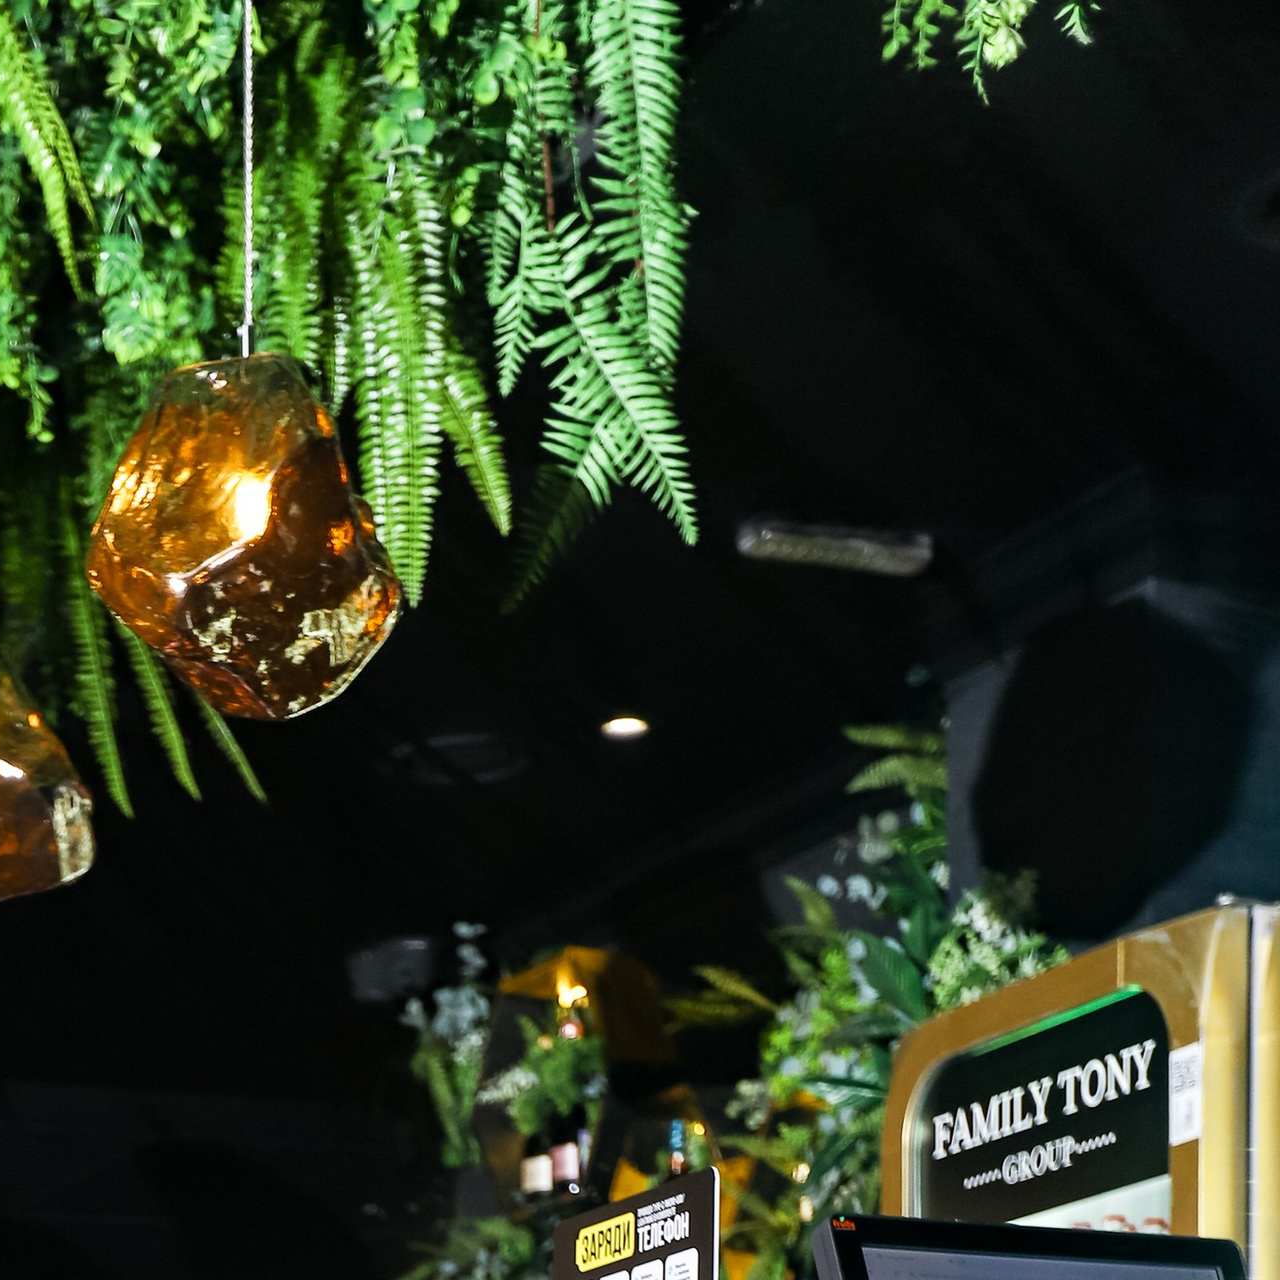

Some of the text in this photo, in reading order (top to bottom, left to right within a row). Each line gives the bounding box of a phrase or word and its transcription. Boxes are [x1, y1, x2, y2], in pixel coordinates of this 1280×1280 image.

[932, 1038, 1157, 1160] FAMILY TONY
[1001, 1135, 1075, 1185] GROUP
[581, 1221, 631, 1264] ЗАРЯДИ
[637, 1211, 690, 1253] ТЕЛЕФОН
